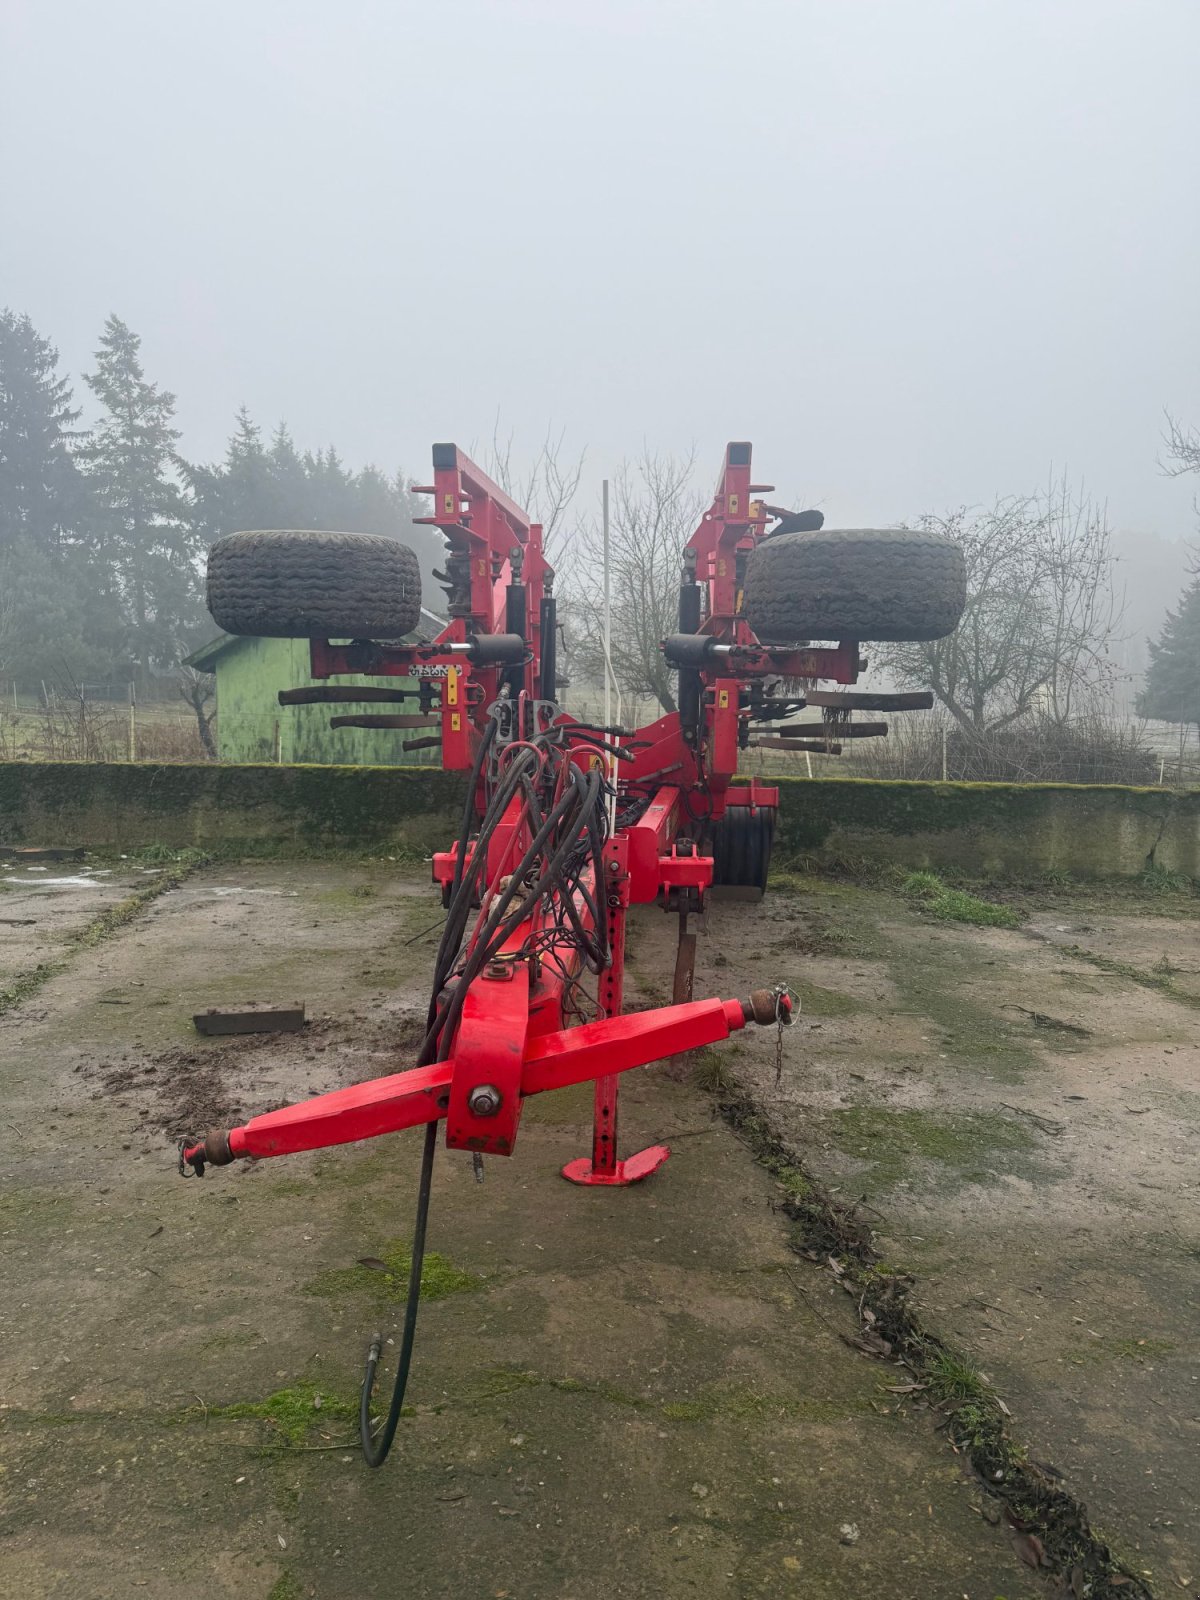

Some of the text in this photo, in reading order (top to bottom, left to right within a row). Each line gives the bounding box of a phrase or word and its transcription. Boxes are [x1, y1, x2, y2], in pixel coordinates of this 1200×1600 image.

[410, 668, 420, 676] 5
[420, 668, 430, 676] 4
[430, 668, 440, 676] 3
